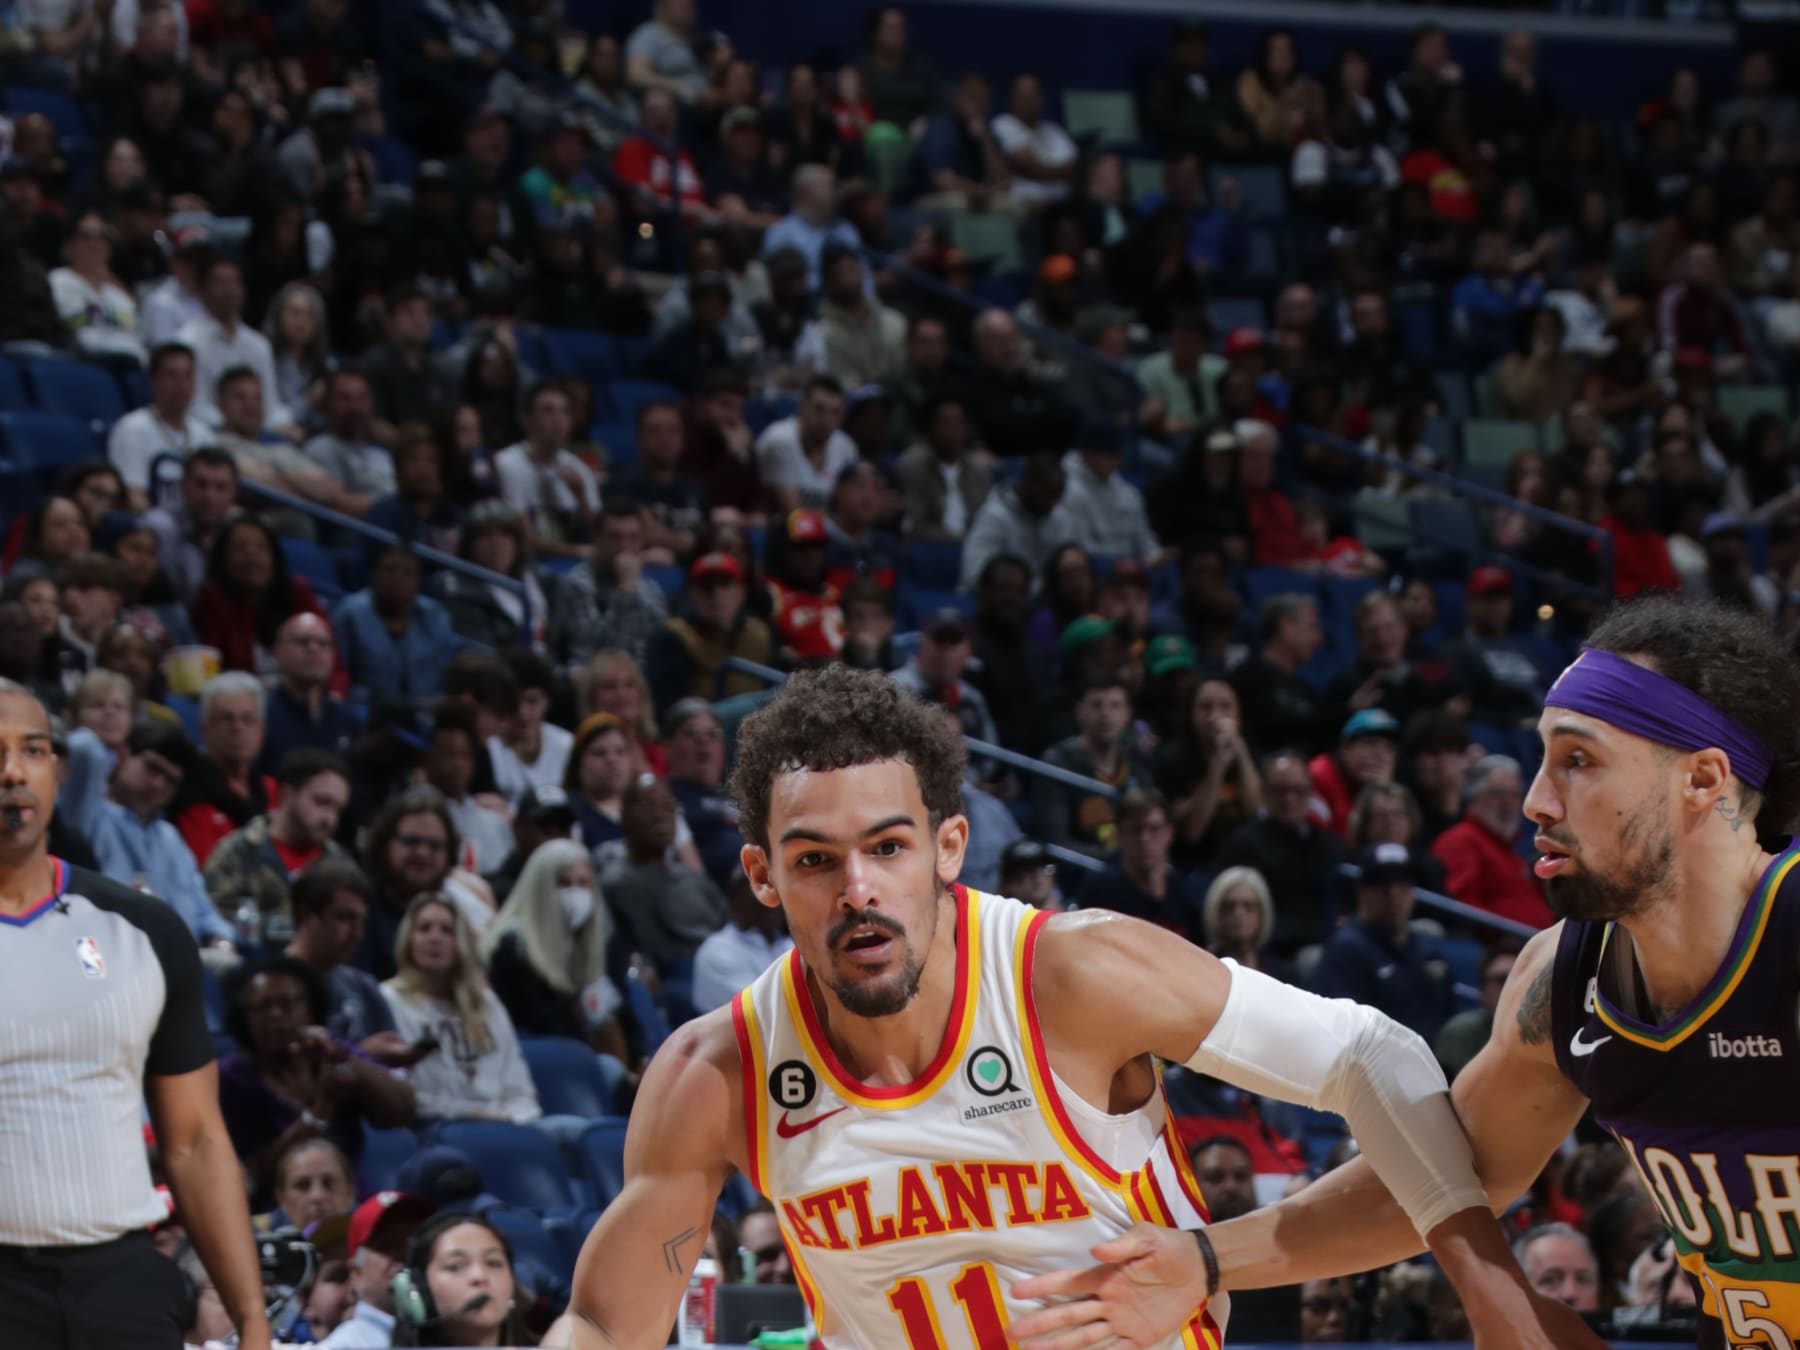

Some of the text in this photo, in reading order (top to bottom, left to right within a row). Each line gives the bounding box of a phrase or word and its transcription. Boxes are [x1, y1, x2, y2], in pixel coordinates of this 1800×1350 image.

[1708, 1032, 1783, 1058] ibotta
[780, 1067, 806, 1104] 6
[964, 1097, 1032, 1121] sharecare
[779, 1160, 1092, 1251] ATLANTA
[1610, 1125, 1800, 1259] OLA
